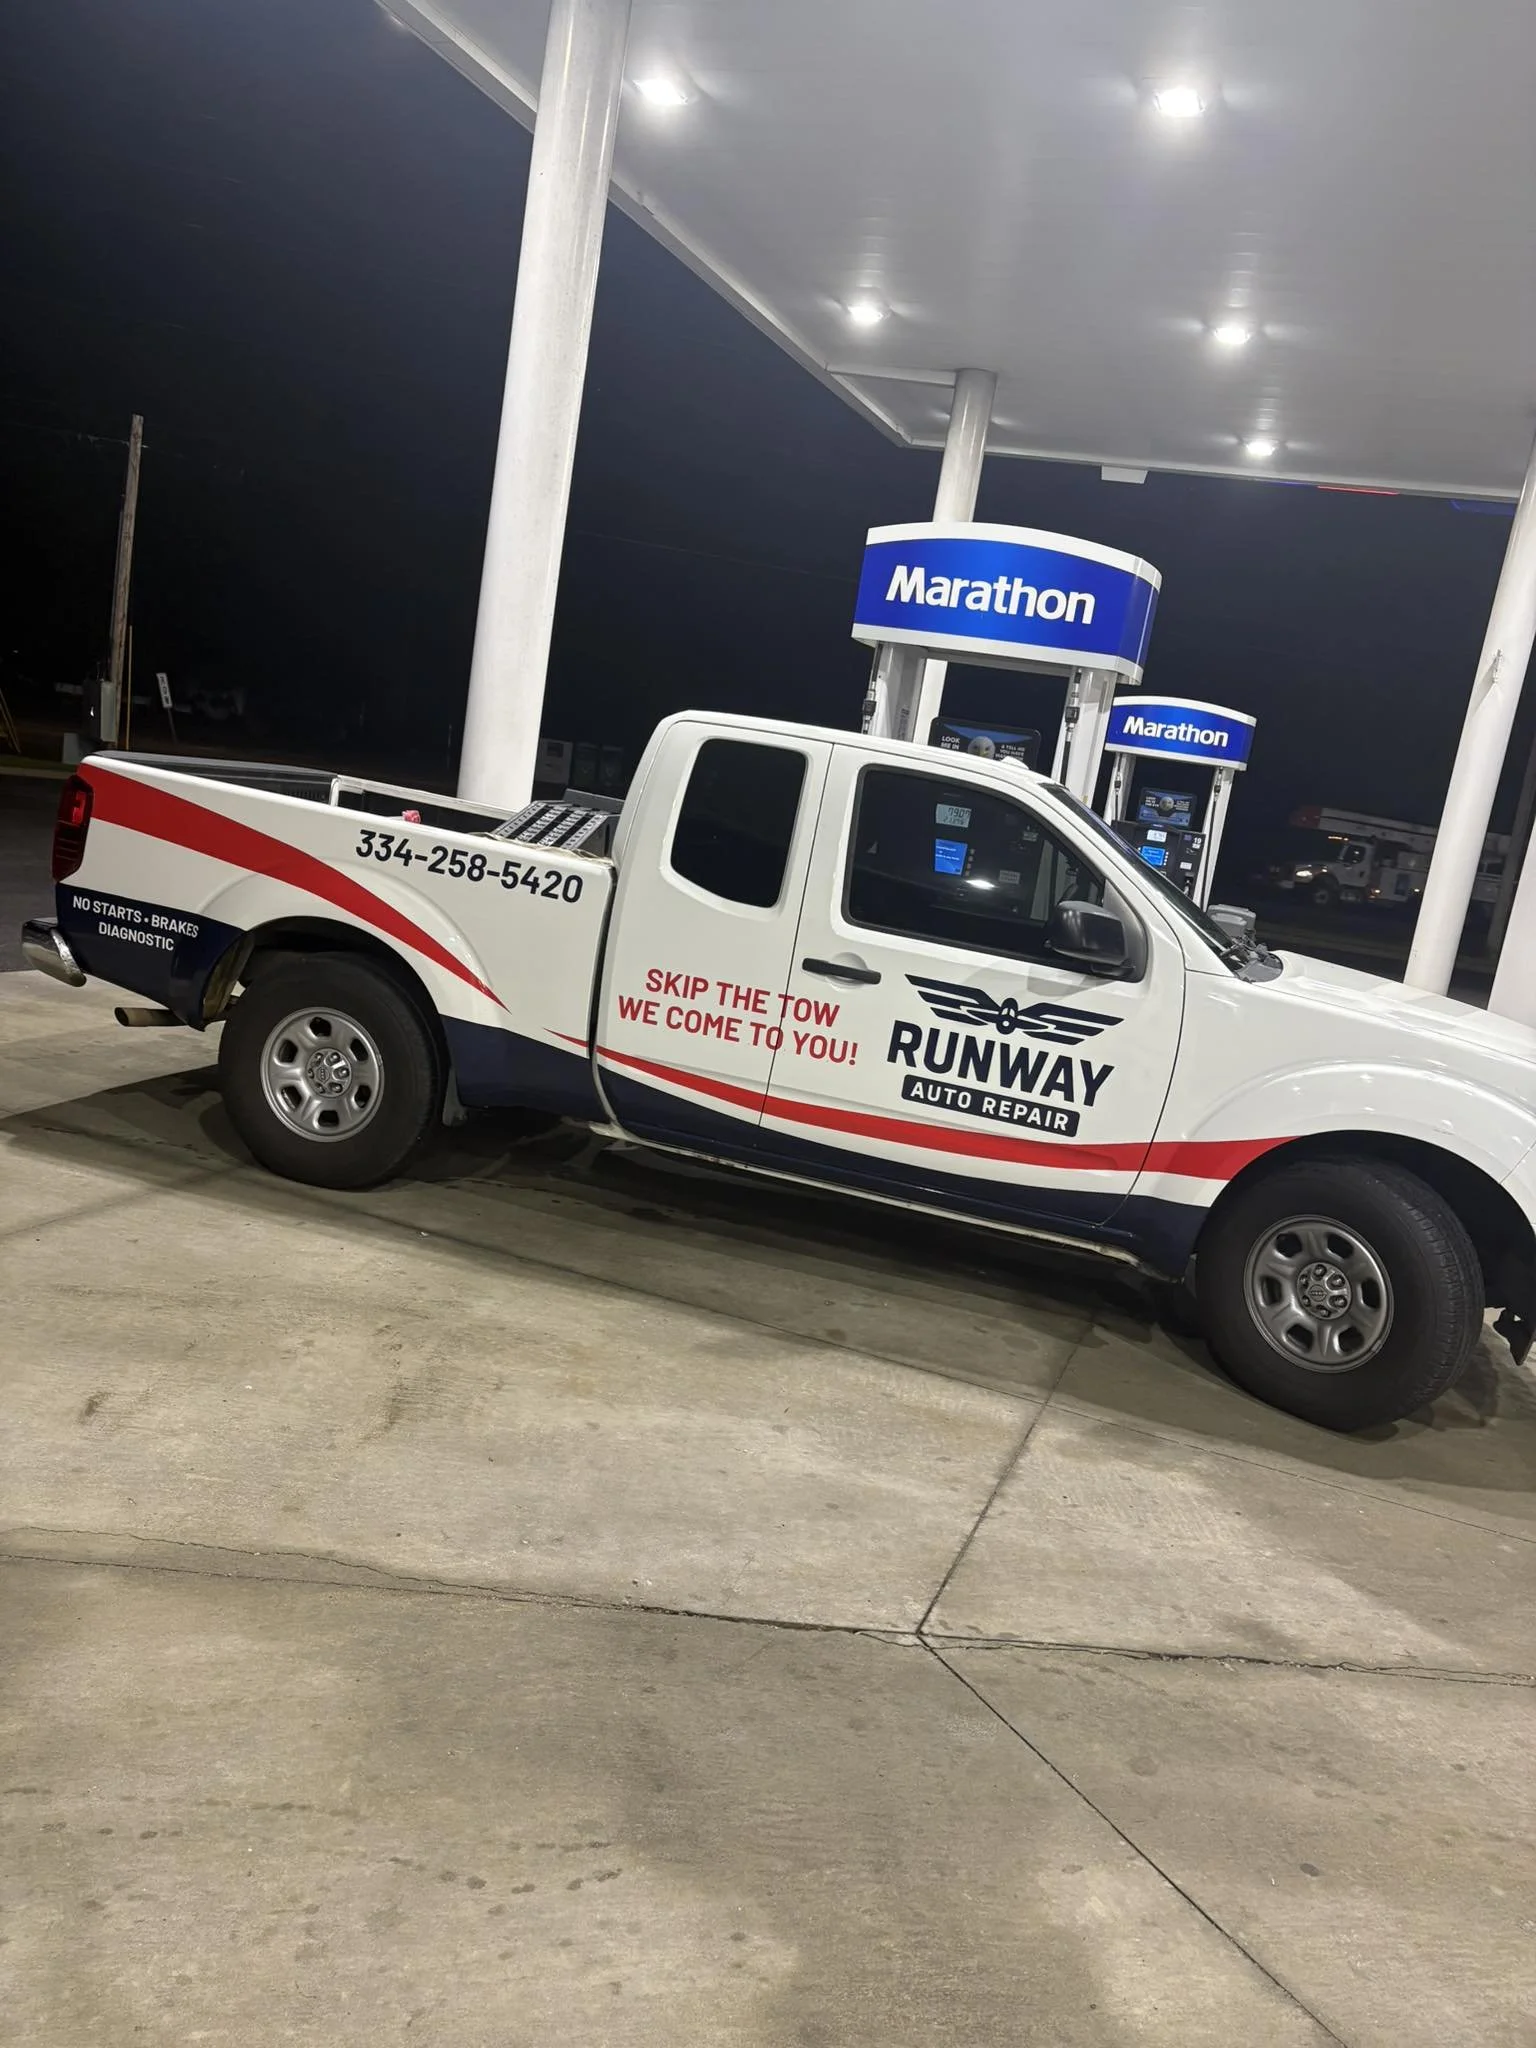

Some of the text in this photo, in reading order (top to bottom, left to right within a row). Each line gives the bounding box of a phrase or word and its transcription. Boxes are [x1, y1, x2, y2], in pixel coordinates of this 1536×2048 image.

[885, 565, 1096, 625] Marathon
[1122, 715, 1229, 748] Marathon
[355, 829, 584, 903] 334-258-5420
[73, 895, 199, 938] NO STARTS BRAKES
[98, 922, 175, 951] DIAGNOSTIC
[645, 968, 840, 1027] SKIP THE TOW
[618, 995, 859, 1066] WE COME TO YOU!
[887, 1019, 1115, 1107] RUNWAY
[910, 1081, 1069, 1131] AUTO REPAIR
